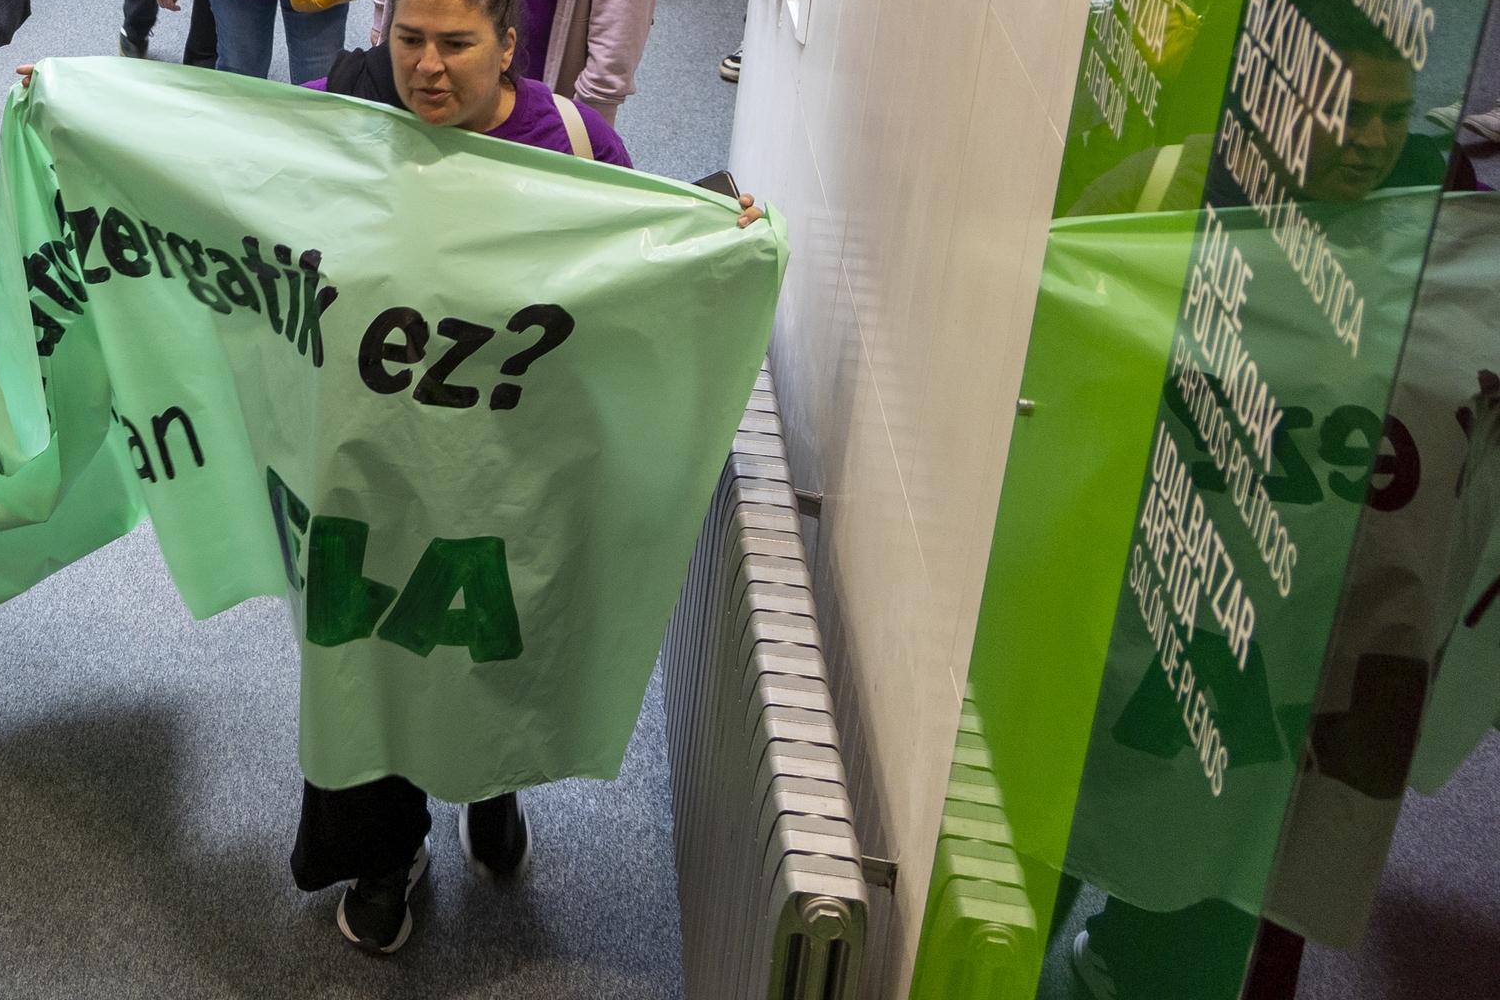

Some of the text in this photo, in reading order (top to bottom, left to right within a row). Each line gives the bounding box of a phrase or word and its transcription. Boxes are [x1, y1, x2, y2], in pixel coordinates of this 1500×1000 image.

[1083, 45, 1127, 142] ATENCIÓN
[1106, 13, 1149, 105] SERVICIO
[1142, 71, 1163, 130] DE
[1230, 32, 1316, 189] POLITIKA
[1198, 203, 1255, 336] TALDE
[1217, 108, 1366, 359] POLÍTICA LINGÜÍSTICA
[357, 302, 576, 412] ez?
[1183, 264, 1285, 473] POLITIKOAK
[1171, 334, 1298, 599] PARTIDOS POLÍTICOS
[1139, 483, 1201, 642] ARETOA
[1151, 421, 1257, 672] UDALBATZAR
[1129, 543, 1230, 798] SALÓN DE PLENOS
